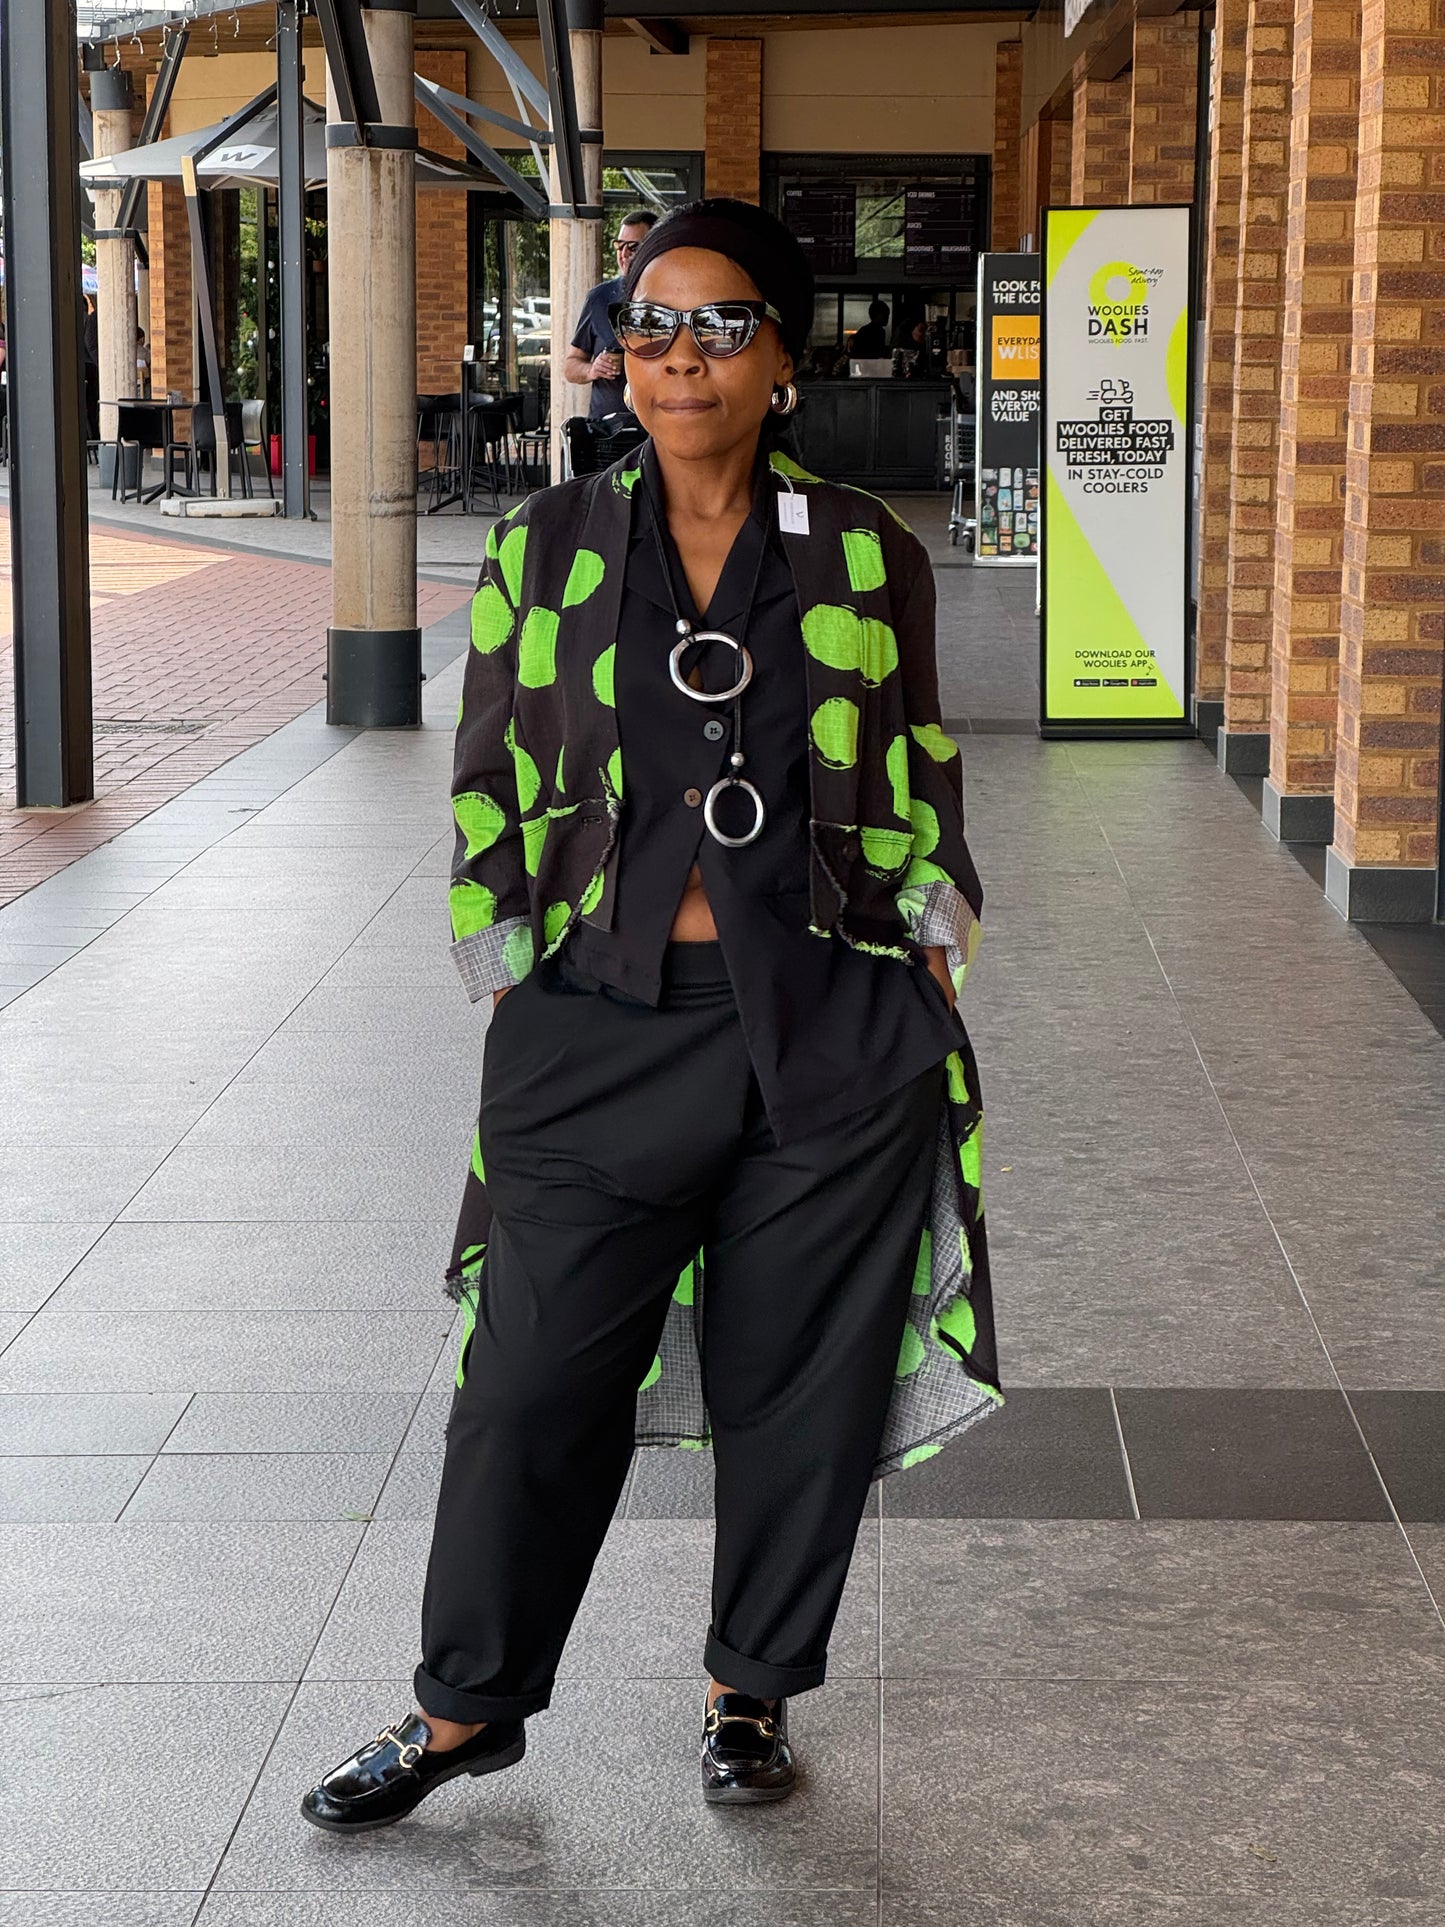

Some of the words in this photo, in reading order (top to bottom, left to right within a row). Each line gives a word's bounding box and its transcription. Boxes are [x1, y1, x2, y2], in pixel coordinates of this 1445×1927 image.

[1128, 267, 1164, 278] Same-day
[992, 280, 1028, 291] LOOK
[1130, 277, 1158, 287] delivery
[992, 292, 1016, 304] THE
[1087, 305, 1149, 316] WOOLIES
[1088, 318, 1148, 336] DASH
[991, 390, 1018, 401] AND
[991, 400, 1041, 411] EVERYD
[991, 411, 1030, 422] VALUE
[1101, 409, 1130, 421] GET
[1059, 423, 1125, 436] WOOLIES
[1128, 422, 1169, 435] FOOD
[1059, 437, 1132, 449] DELIVERED
[1135, 436, 1171, 450] FAST,
[1068, 451, 1116, 464] FRESH,
[1117, 450, 1163, 462] TODAY
[1068, 469, 1082, 480] IN
[1088, 468, 1164, 480] STAY-COLD
[1083, 482, 1148, 493] COOLERS
[1074, 650, 1132, 658] DOWNLOAD
[1135, 649, 1156, 658] OUR
[1083, 659, 1128, 668] WOOLIES
[1130, 659, 1148, 667] APP
